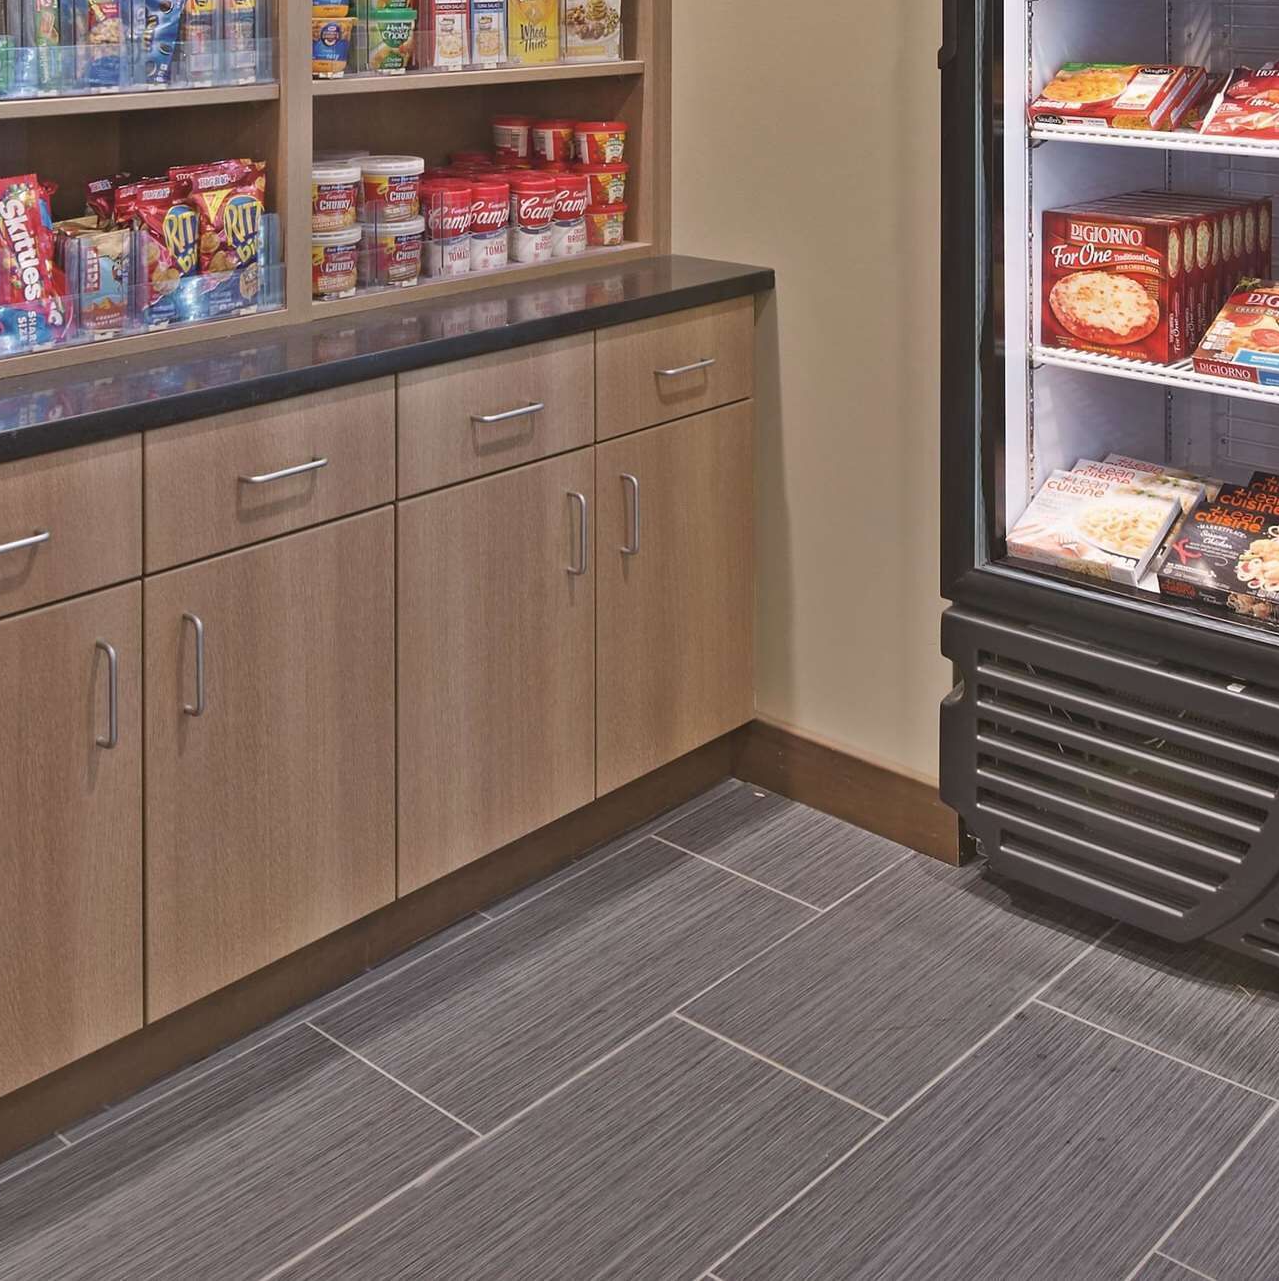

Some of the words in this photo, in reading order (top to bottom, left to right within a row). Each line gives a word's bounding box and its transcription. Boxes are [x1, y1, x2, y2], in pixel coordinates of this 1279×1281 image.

[521, 24, 546, 39] Wheat
[1051, 245, 1080, 267] For
[1079, 243, 1111, 263] One
[1145, 256, 1160, 265] Crust
